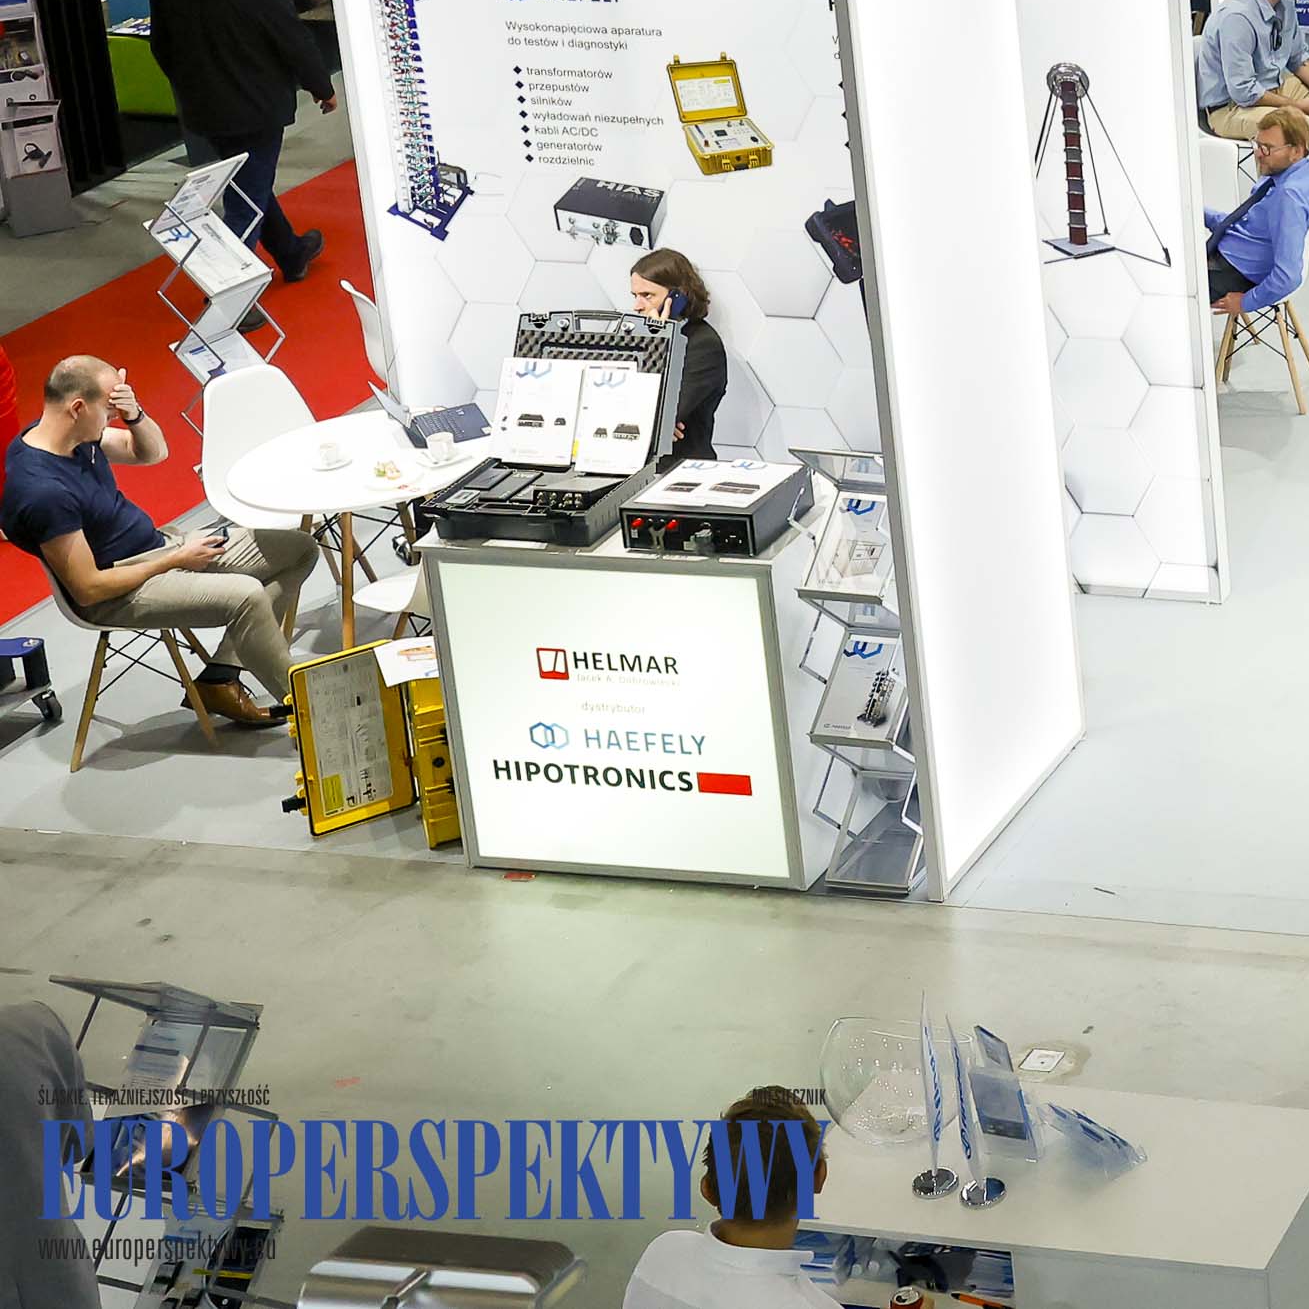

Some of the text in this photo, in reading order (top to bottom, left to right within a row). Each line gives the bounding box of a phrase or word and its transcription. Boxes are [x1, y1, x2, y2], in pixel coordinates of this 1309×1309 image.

[505, 20, 663, 38] Wysokonapięciowa aparatura
[507, 36, 522, 46] do
[524, 36, 559, 48] testów
[567, 39, 628, 52] diagnostyki
[526, 66, 613, 79] transformatorów
[528, 81, 590, 93] przepustów
[530, 96, 572, 107] silników
[532, 111, 664, 128] wyładowań niezupełnych
[534, 125, 599, 138] kabli AC/DC
[536, 141, 602, 152] generatorów
[538, 155, 595, 166] rozdzielnic
[596, 180, 661, 198] HIAS
[573, 651, 679, 675] HELMAR
[581, 700, 646, 715] dystrybutor
[584, 729, 706, 755] HAEFELY
[492, 759, 694, 792] HIPOTRONICS
